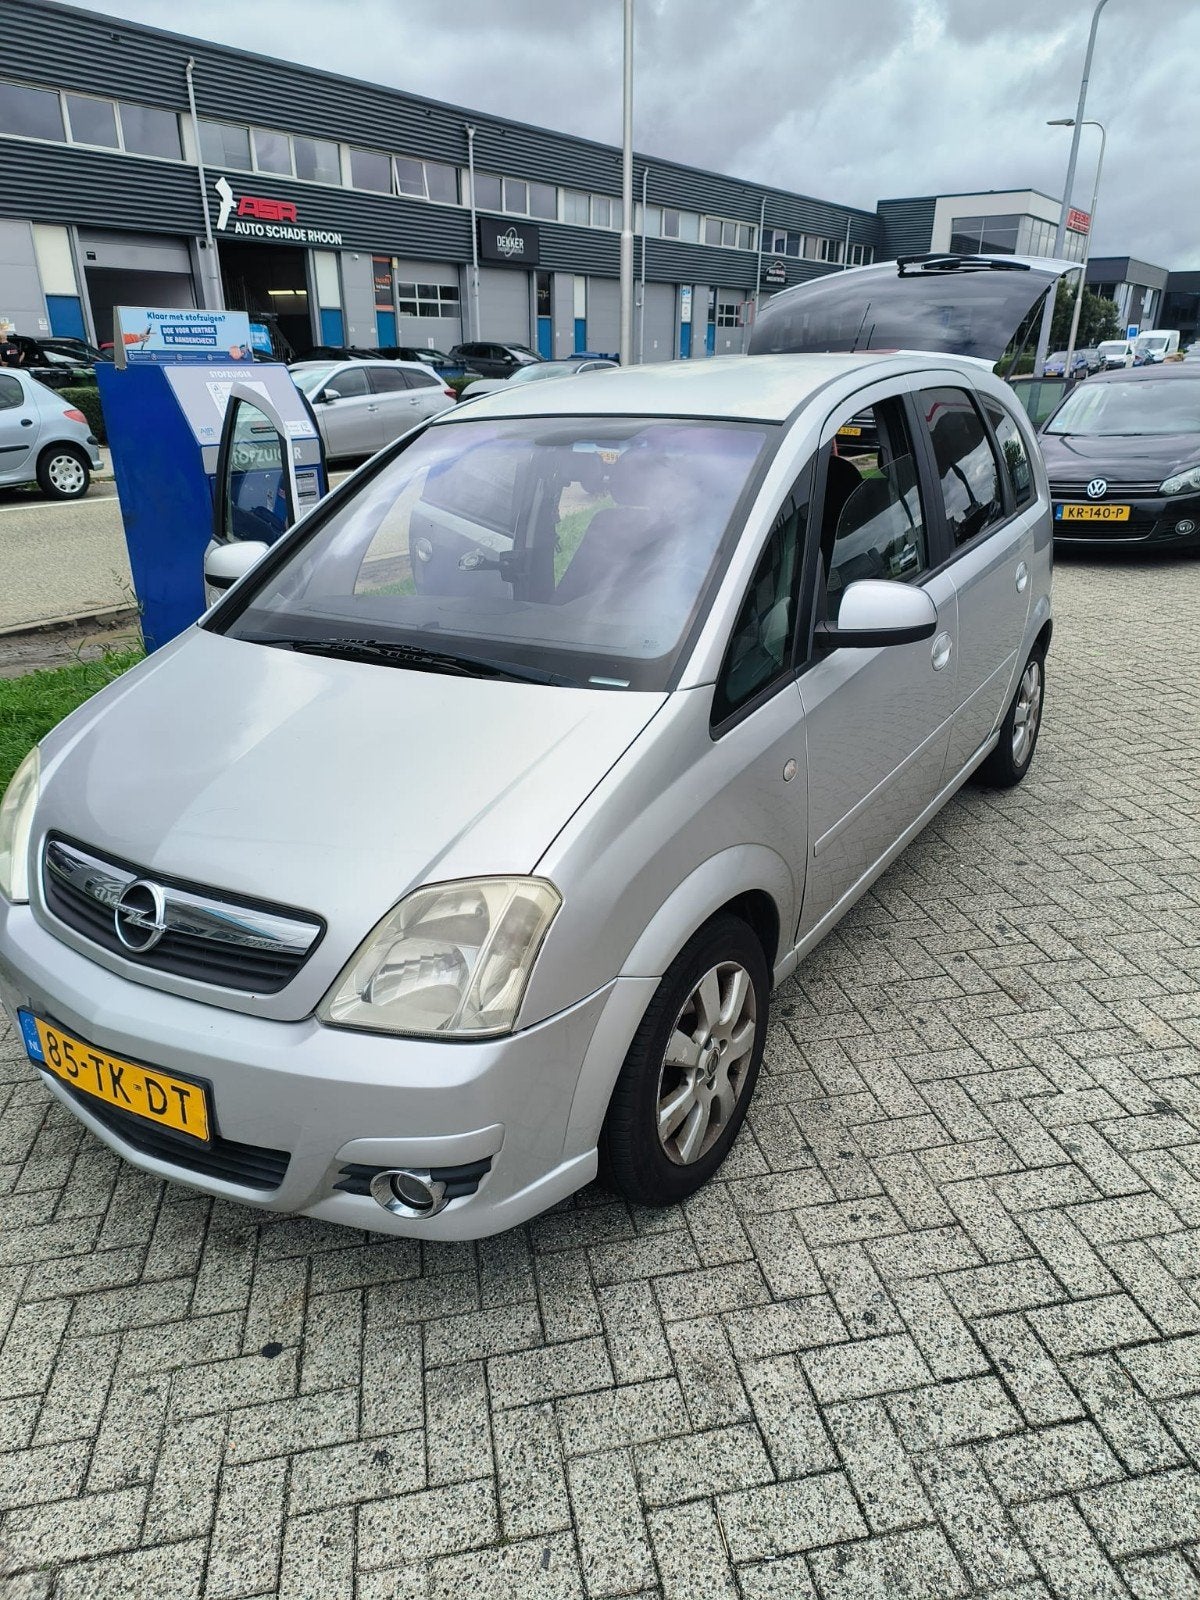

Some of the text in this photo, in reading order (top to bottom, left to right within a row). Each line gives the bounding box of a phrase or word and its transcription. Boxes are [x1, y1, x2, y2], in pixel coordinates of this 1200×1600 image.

[237, 196, 297, 222] ASR
[235, 222, 342, 244] AUTO SCHADE RHOON
[497, 235, 524, 249] DEKKER
[146, 311, 168, 320] Klaar
[185, 313, 226, 323] stofzuigen?
[174, 326, 190, 334] VOOR
[190, 326, 216, 334] VERTREK
[209, 370, 252, 378] STOFZUIGER
[1068, 507, 1124, 519] KR-140-P
[28, 1040, 42, 1053] NL
[46, 1031, 191, 1125] 85-TK-DT
